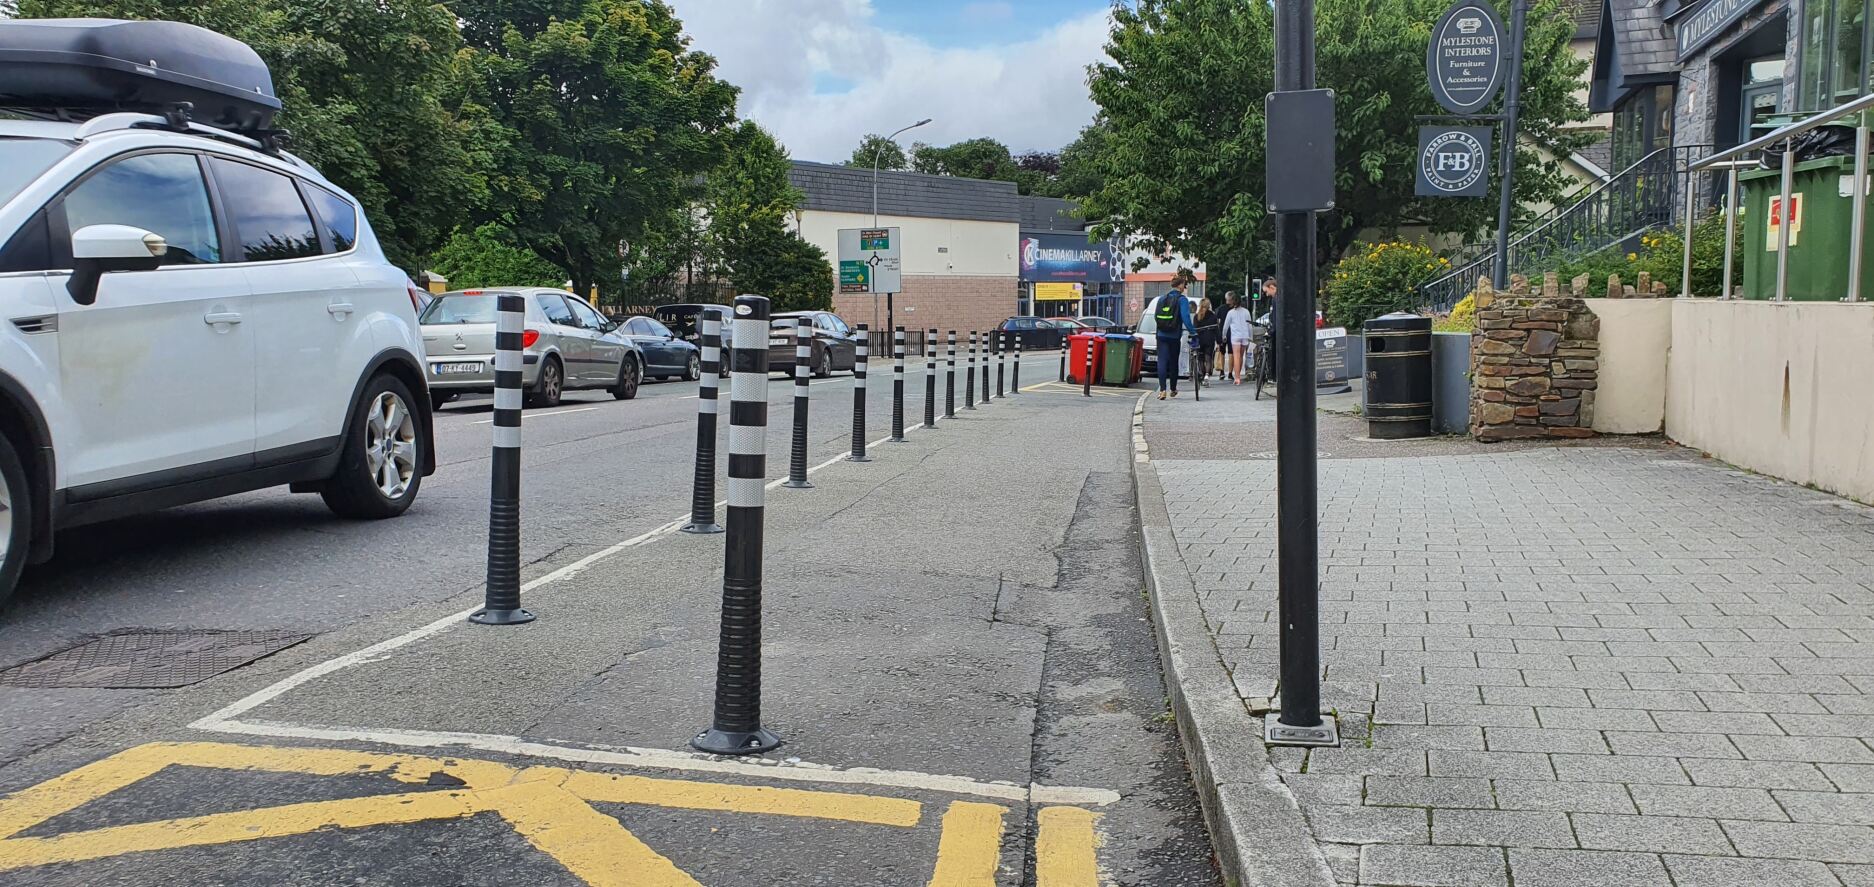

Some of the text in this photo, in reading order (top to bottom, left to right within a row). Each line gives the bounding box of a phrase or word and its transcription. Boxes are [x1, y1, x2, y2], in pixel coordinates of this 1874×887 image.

[1442, 36, 1495, 47] MYLESTONE
[1445, 46, 1492, 57] INTERIORS
[1449, 60, 1486, 68] Furniture
[1462, 68, 1471, 76] &
[1446, 75, 1488, 83] Accessories
[1426, 133, 1457, 157] FARROW
[1467, 138, 1481, 158] BALL
[1436, 152, 1471, 171] F&B
[1426, 167, 1445, 187] PAINT
[1458, 168, 1480, 188] PAPER
[1318, 329, 1340, 338] OPEN
